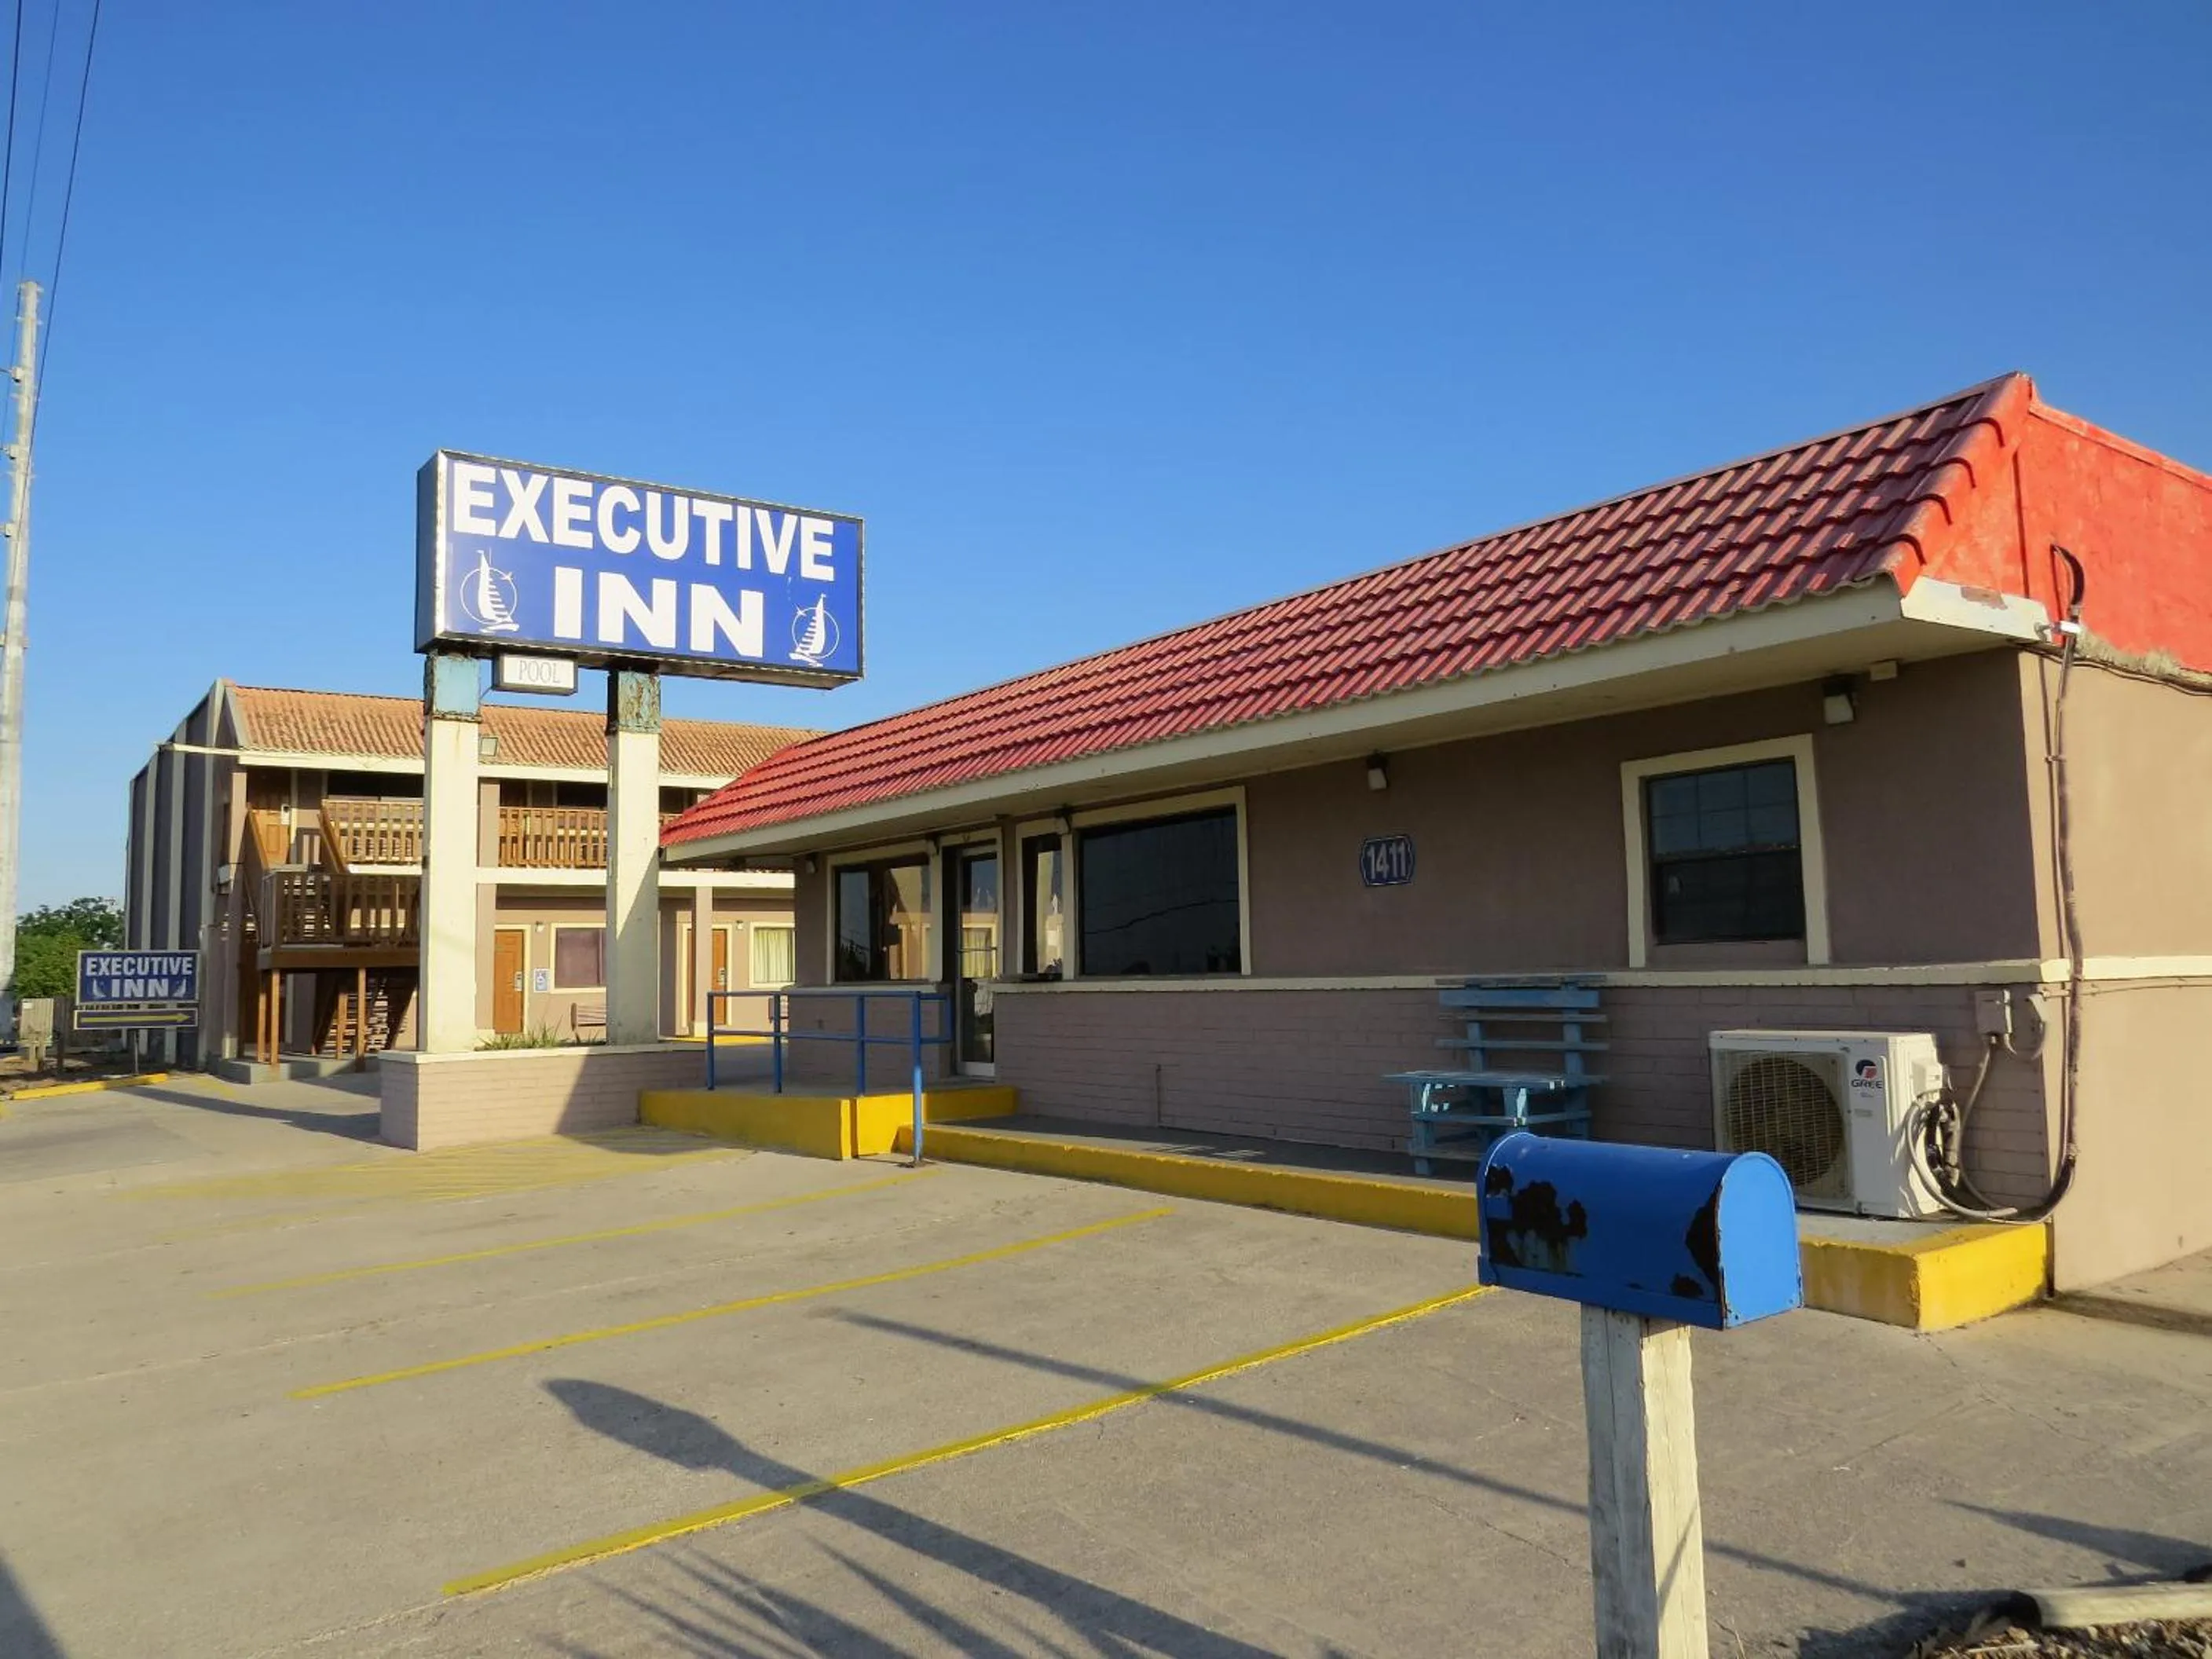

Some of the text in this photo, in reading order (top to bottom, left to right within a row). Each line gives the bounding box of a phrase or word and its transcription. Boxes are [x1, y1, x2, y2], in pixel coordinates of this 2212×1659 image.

[453, 463, 835, 581] EXECUTIVE
[554, 566, 764, 658] INN
[518, 660, 561, 683] POOL
[1367, 842, 1407, 880] 1411
[86, 956, 193, 976] EXECUTIVE
[111, 978, 169, 998] INN
